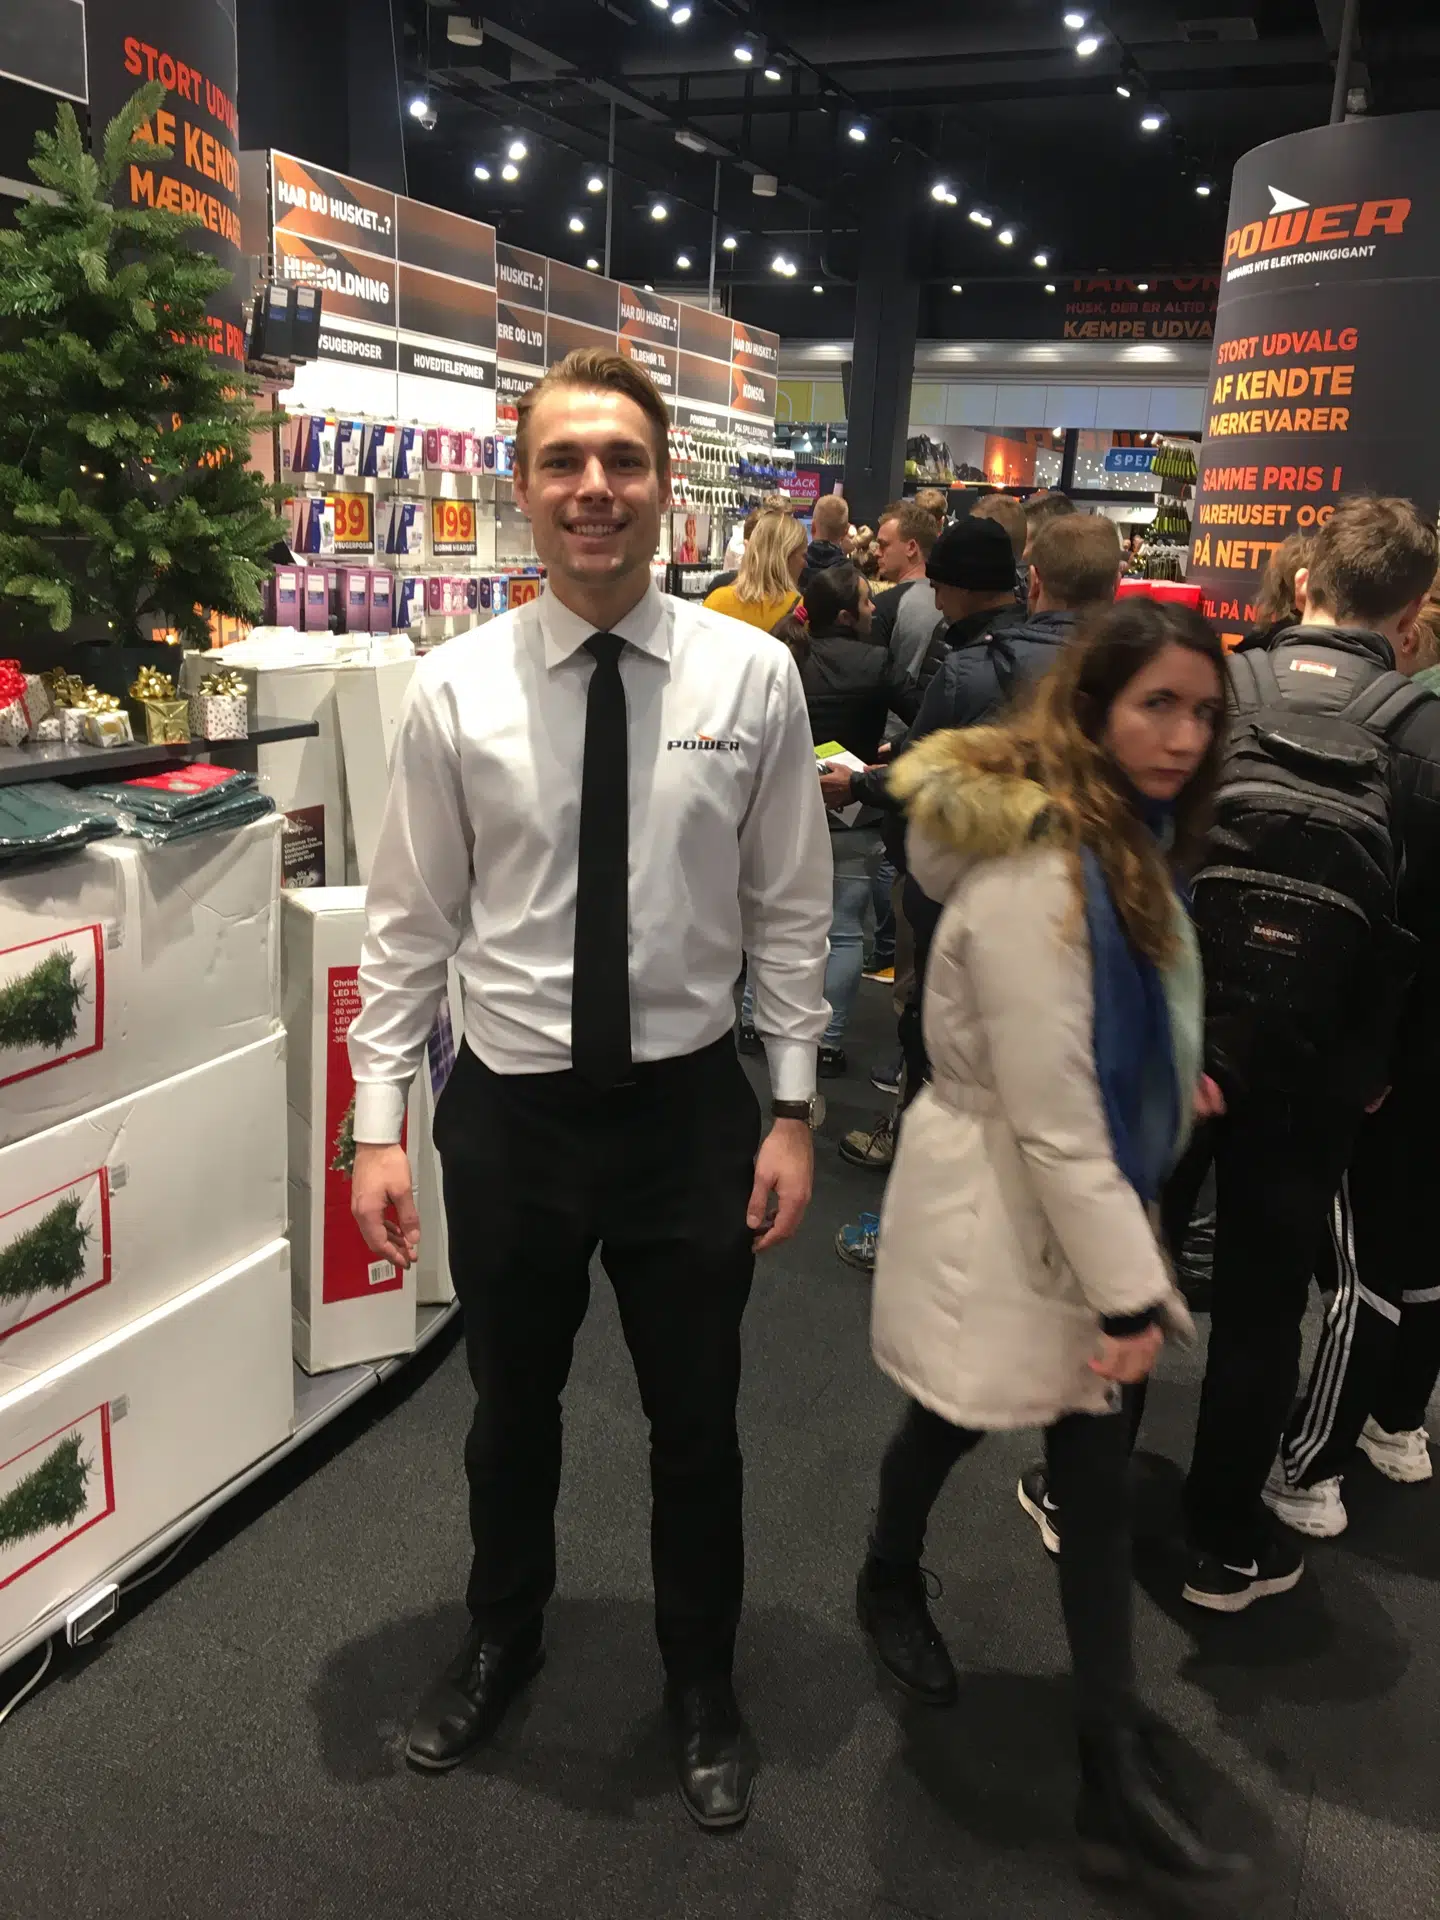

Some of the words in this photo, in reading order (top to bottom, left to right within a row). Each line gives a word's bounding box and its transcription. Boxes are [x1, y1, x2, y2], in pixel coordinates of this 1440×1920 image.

[124, 36, 202, 105] STORT
[278, 180, 307, 209] HAR
[310, 192, 327, 215] DU
[330, 198, 391, 235] HUSKET..?
[1224, 198, 1411, 267] POWER
[1254, 258, 1269, 273] NYE
[1270, 245, 1376, 269] ELEKTRONIKGIGANT
[500, 264, 543, 291] HUSKET..?
[621, 303, 635, 319] HAR
[636, 307, 645, 322] DU
[646, 310, 677, 332] HUSKET..?
[1110, 302, 1138, 313] DER
[1142, 302, 1161, 313] ER
[1164, 302, 1205, 313] ALTID
[515, 326, 526, 343] OG
[527, 329, 542, 347] LYD
[1063, 320, 1146, 338] KÆMPE
[733, 338, 745, 351] HAR
[746, 341, 752, 354] DU
[1217, 336, 1258, 365] STORT
[1262, 327, 1358, 357] UDVALG
[413, 353, 484, 381] HOVEDTELEFONER
[657, 354, 667, 368] TIL
[743, 383, 766, 402] KONSOL
[1212, 374, 1233, 405] AF
[1236, 365, 1355, 402] KENDTE
[1208, 407, 1349, 437] MÆRKEVARER
[783, 478, 816, 488] BLACK
[1202, 467, 1258, 491] SAMME
[1263, 467, 1323, 491] PRIS
[1332, 467, 1343, 491] I
[435, 505, 472, 538] 199
[1199, 504, 1291, 526] VAREHUSET
[1297, 505, 1335, 527] OG
[1193, 533, 1211, 567] PÅ
[1220, 599, 1240, 620] PÅ
[667, 740, 740, 751] POWER
[1254, 925, 1295, 941] EASTPAK
[333, 989, 349, 997] LED
[334, 1016, 350, 1025] LED
